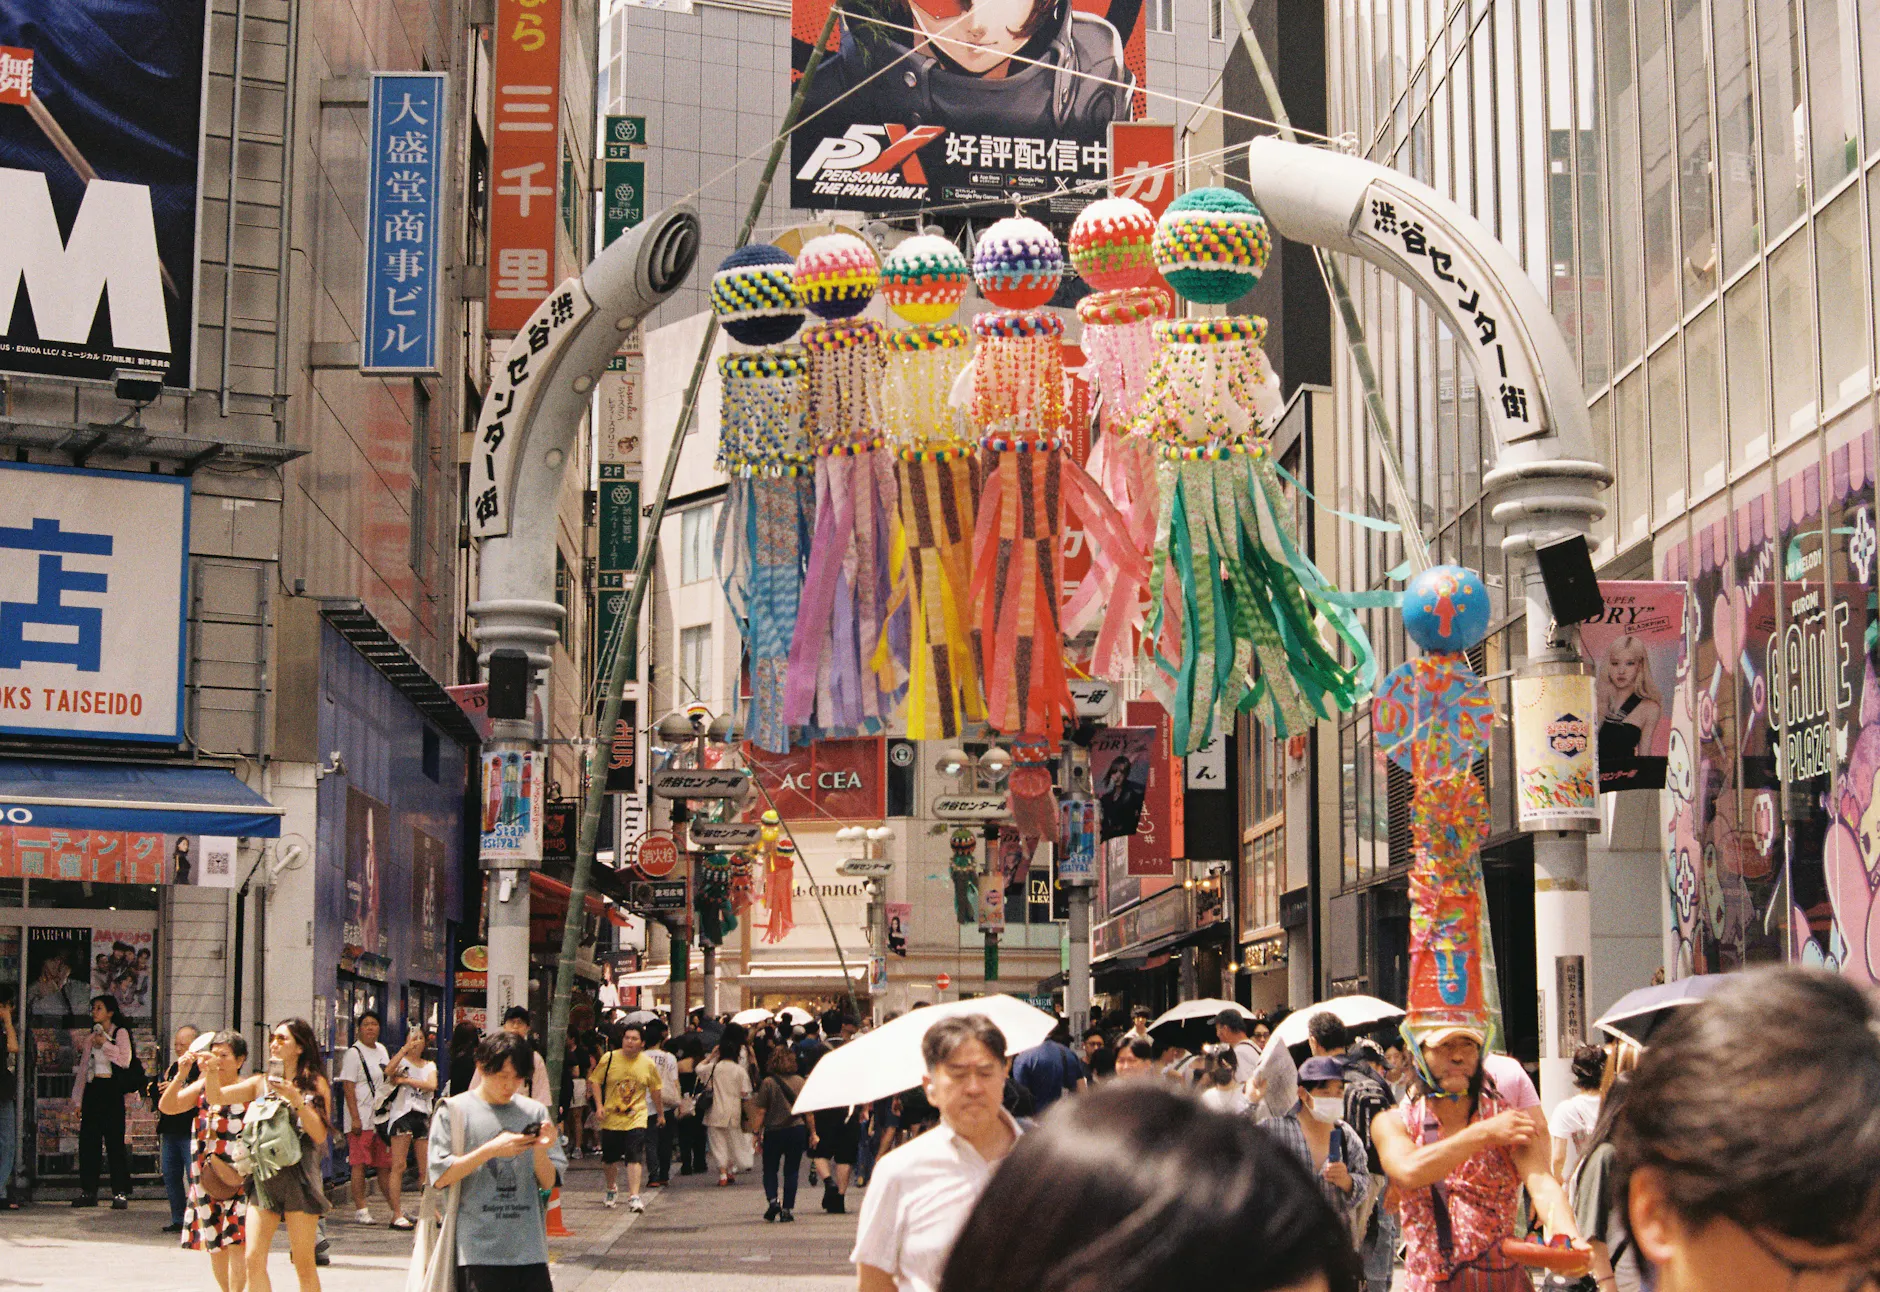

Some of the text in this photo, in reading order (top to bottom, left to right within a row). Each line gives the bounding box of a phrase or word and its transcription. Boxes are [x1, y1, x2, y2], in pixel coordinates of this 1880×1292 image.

[610, 147, 628, 157] 5F
[945, 131, 1108, 174] 好評配信中
[818, 169, 900, 184] PERSONA5
[495, 85, 553, 300] 三千里
[812, 181, 840, 194] THE
[839, 183, 914, 199] PHANTOM
[380, 91, 430, 356] 大盛堂商事ビル
[1371, 199, 1530, 424] 渋谷センター街
[16, 345, 41, 354] EXNOA
[61, 349, 100, 361] ミュージカル
[474, 291, 575, 528] 渋谷センター街
[604, 466, 622, 476] 2F
[1797, 548, 1822, 573] MELODY
[603, 577, 620, 586] 1F
[1606, 596, 1636, 604] UPER
[1791, 590, 1819, 617] KUROMI
[0, 686, 143, 717] KS TAISEIDO
[1787, 721, 1834, 784] PLAZA
[657, 776, 744, 788] 渋谷センター街
[780, 771, 862, 791] ACCEA
[495, 823, 525, 837] Star
[702, 829, 758, 838] 谷センター街
[641, 847, 675, 865] 消火栓
